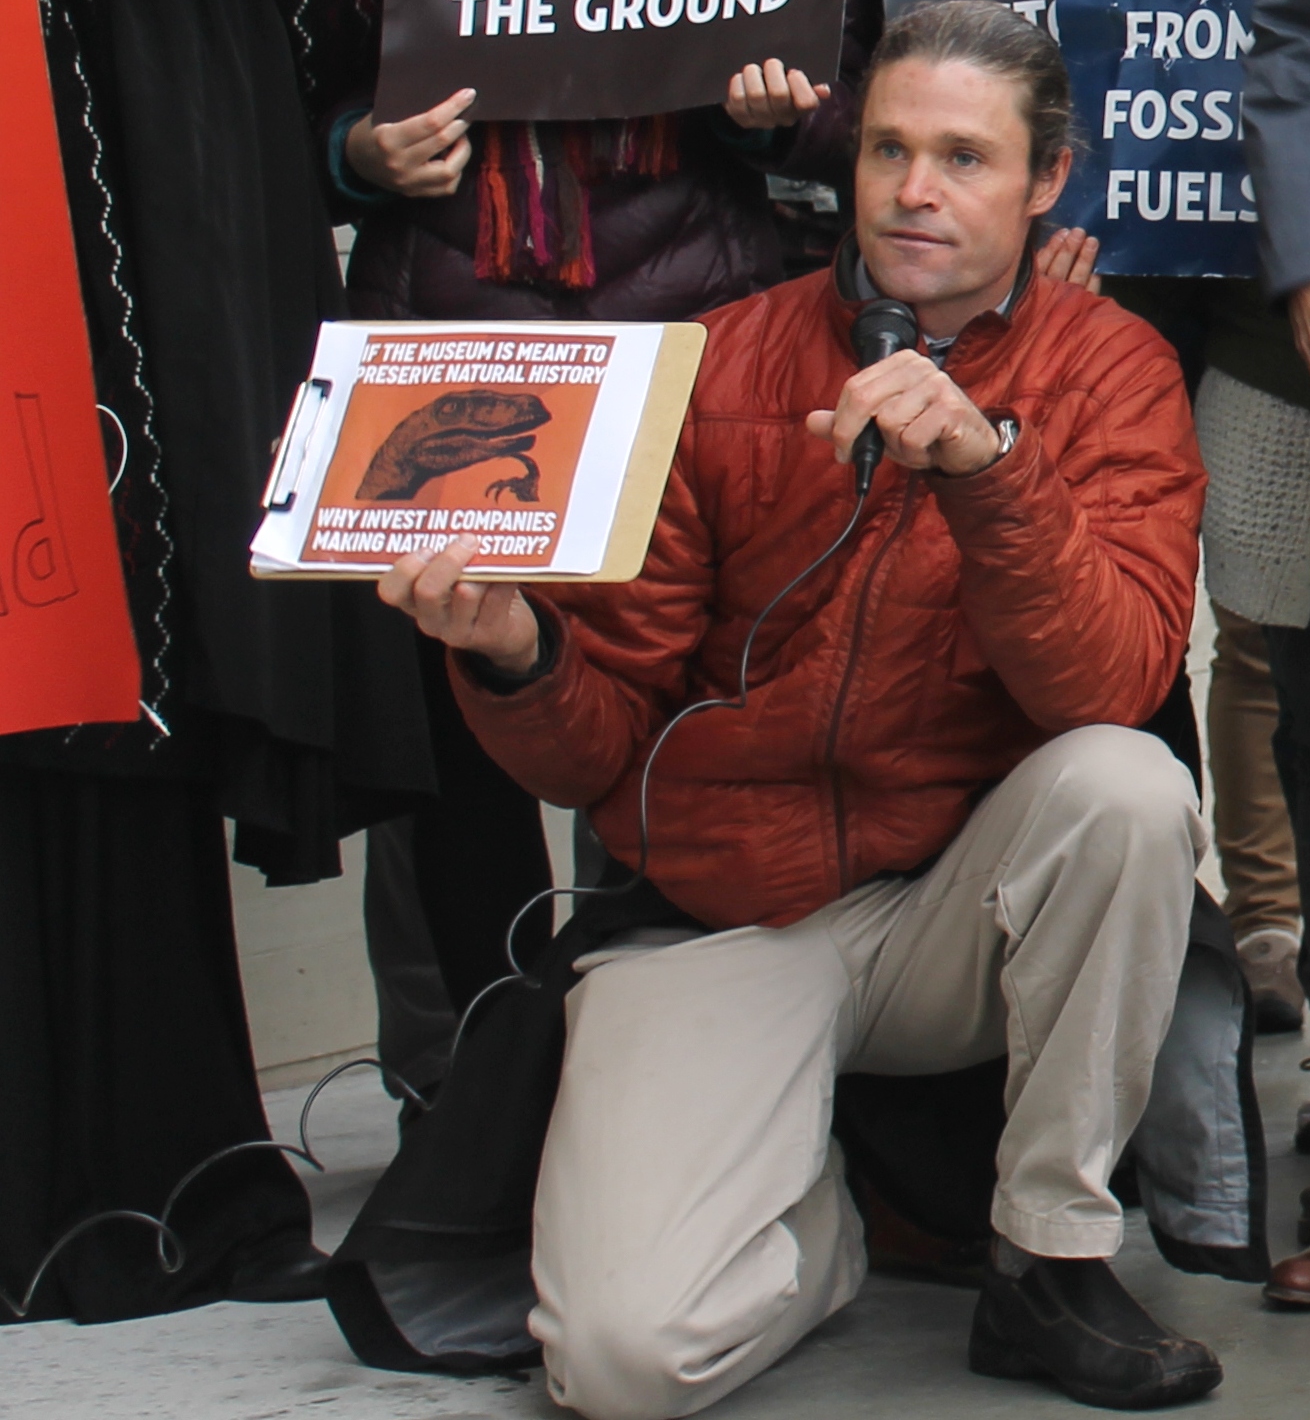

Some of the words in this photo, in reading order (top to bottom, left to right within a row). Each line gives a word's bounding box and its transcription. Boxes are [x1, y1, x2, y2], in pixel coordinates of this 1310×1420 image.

[1102, 89, 1245, 141] FOSS
[361, 343, 379, 363] IF
[384, 343, 418, 363] THE
[417, 342, 495, 363] MUSEUM
[495, 342, 515, 362] IS
[515, 343, 584, 363] MEANT
[584, 344, 608, 363] TO
[354, 364, 445, 385] PRESERVE
[445, 363, 525, 384] NATURAL
[528, 365, 609, 385] HISTORY
[317, 508, 361, 529] WHY
[360, 509, 428, 530] INVEST
[428, 510, 449, 530] IN
[450, 511, 558, 532] COMPANIES
[312, 530, 384, 553] MAKING
[475, 535, 550, 556] STORY?
